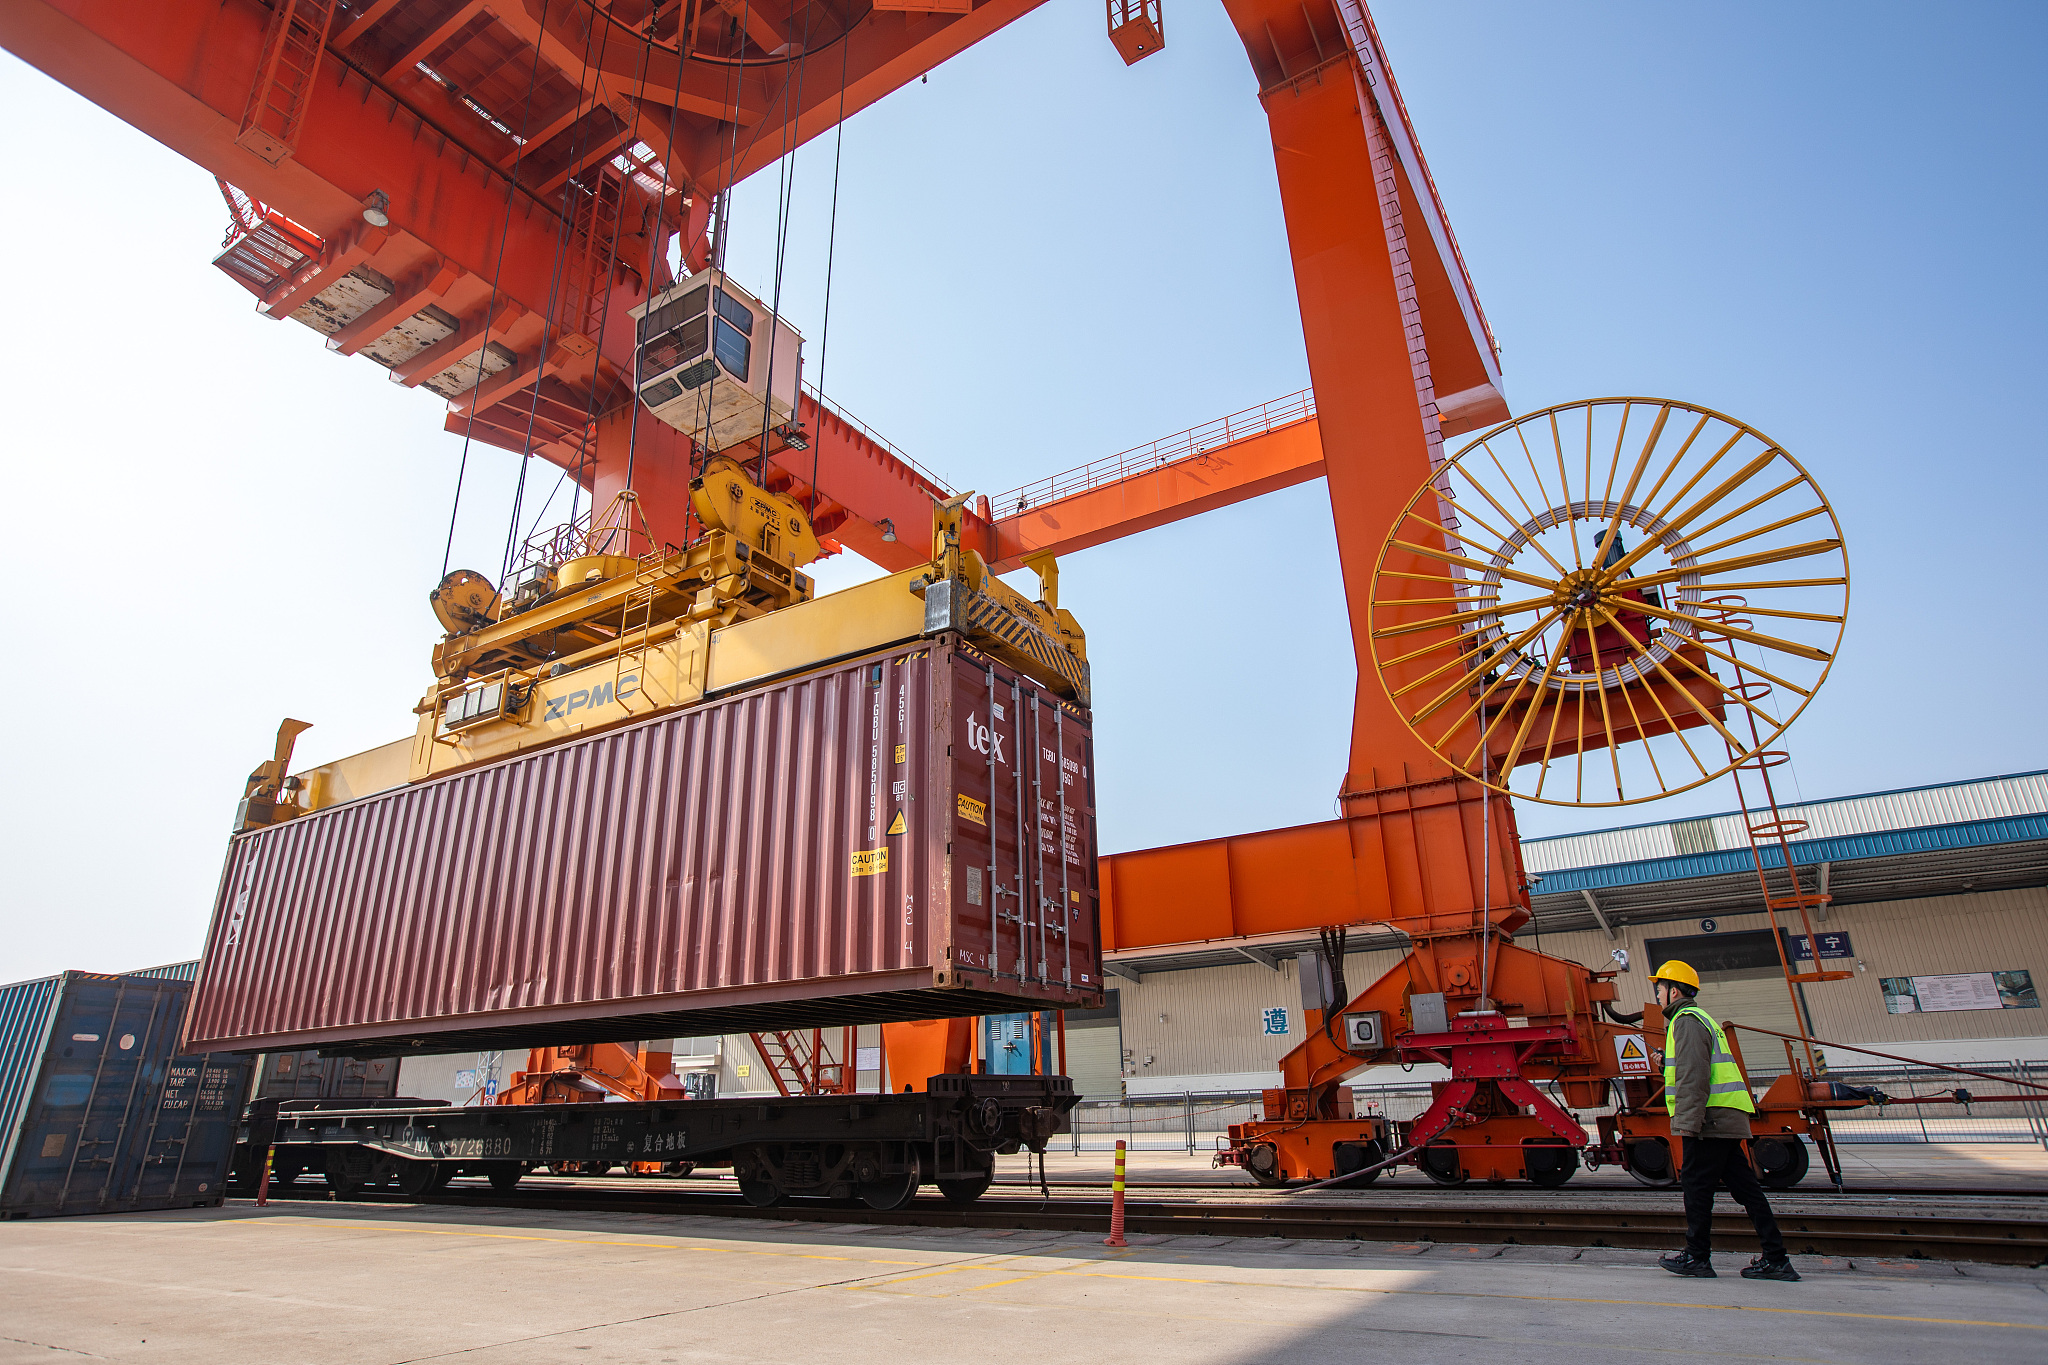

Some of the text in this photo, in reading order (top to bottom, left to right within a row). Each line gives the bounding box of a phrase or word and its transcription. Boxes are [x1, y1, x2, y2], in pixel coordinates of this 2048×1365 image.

[755, 500, 776, 516] ZPMC
[982, 576, 989, 588] 4
[1014, 600, 1040, 622] ZPMC
[544, 674, 638, 722] ZPMC
[872, 692, 880, 740] TGBU
[1042, 747, 1056, 764] TGBU
[1062, 756, 1078, 774] 85098
[870, 745, 878, 822] 585098
[958, 798, 984, 815] CAUTION
[904, 894, 913, 954] MSC 4
[1706, 921, 1712, 930] 5
[960, 949, 984, 966] MSC 4
[1264, 1008, 1288, 1034] 遵
[1400, 1008, 1405, 1017] 2
[171, 1068, 197, 1076] MAX.GR.
[169, 1078, 186, 1086] TARE
[165, 1090, 179, 1098] NET
[450, 1138, 511, 1155] 5726880
[643, 1131, 686, 1153] 复合地板
[1305, 1137, 1309, 1146] 1
[1484, 1136, 1492, 1145] 2
